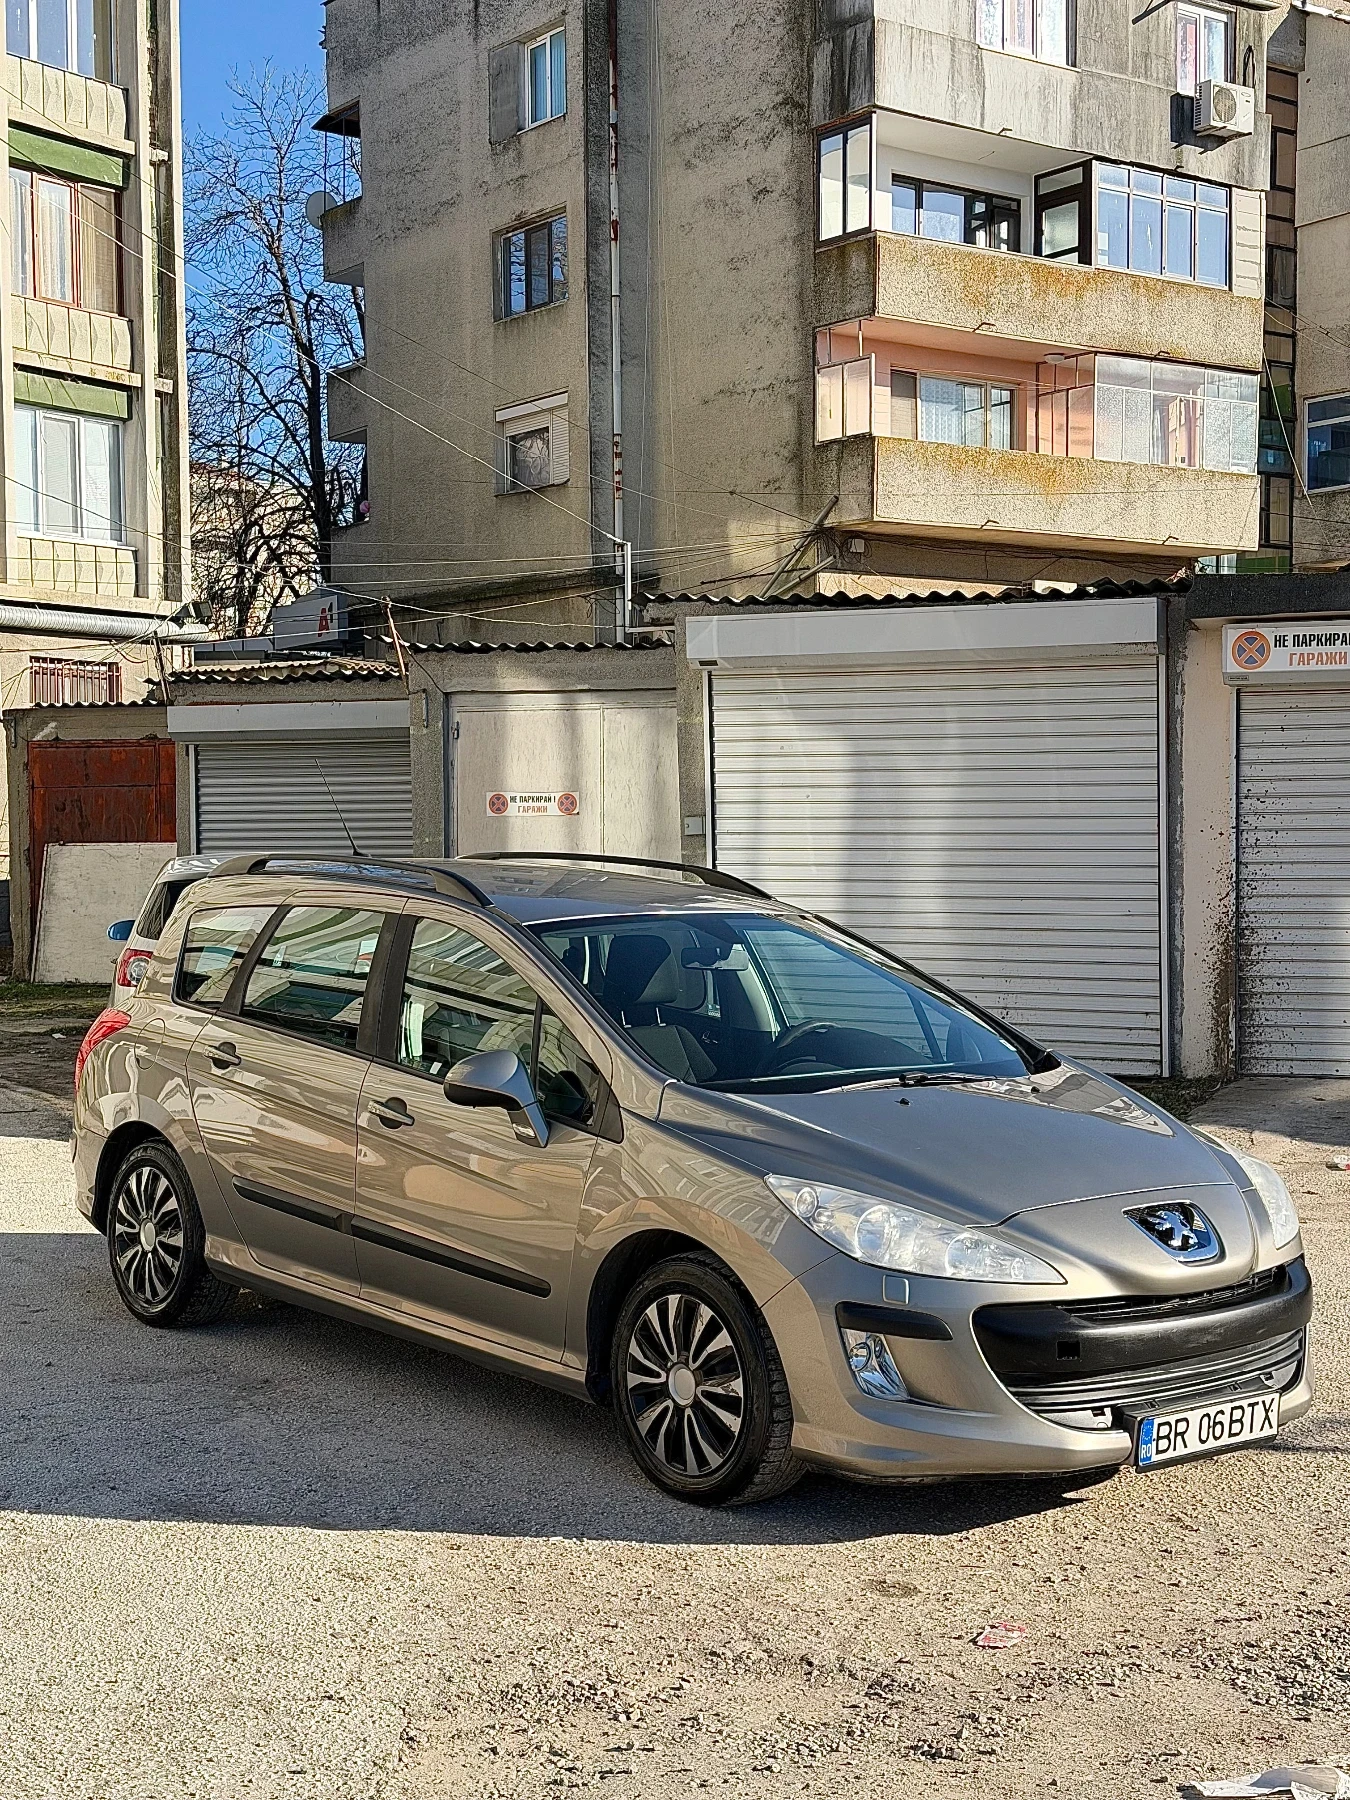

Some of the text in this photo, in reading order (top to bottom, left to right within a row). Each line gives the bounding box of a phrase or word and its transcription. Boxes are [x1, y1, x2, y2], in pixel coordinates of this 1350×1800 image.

[1274, 633, 1350, 648] НЕ ПАРКИРА
[1289, 652, 1347, 666] ГАРАЖИ
[519, 794, 552, 803] ПАРКИРАЙ
[1155, 1417, 1190, 1455] BR
[1141, 1443, 1152, 1459] RO
